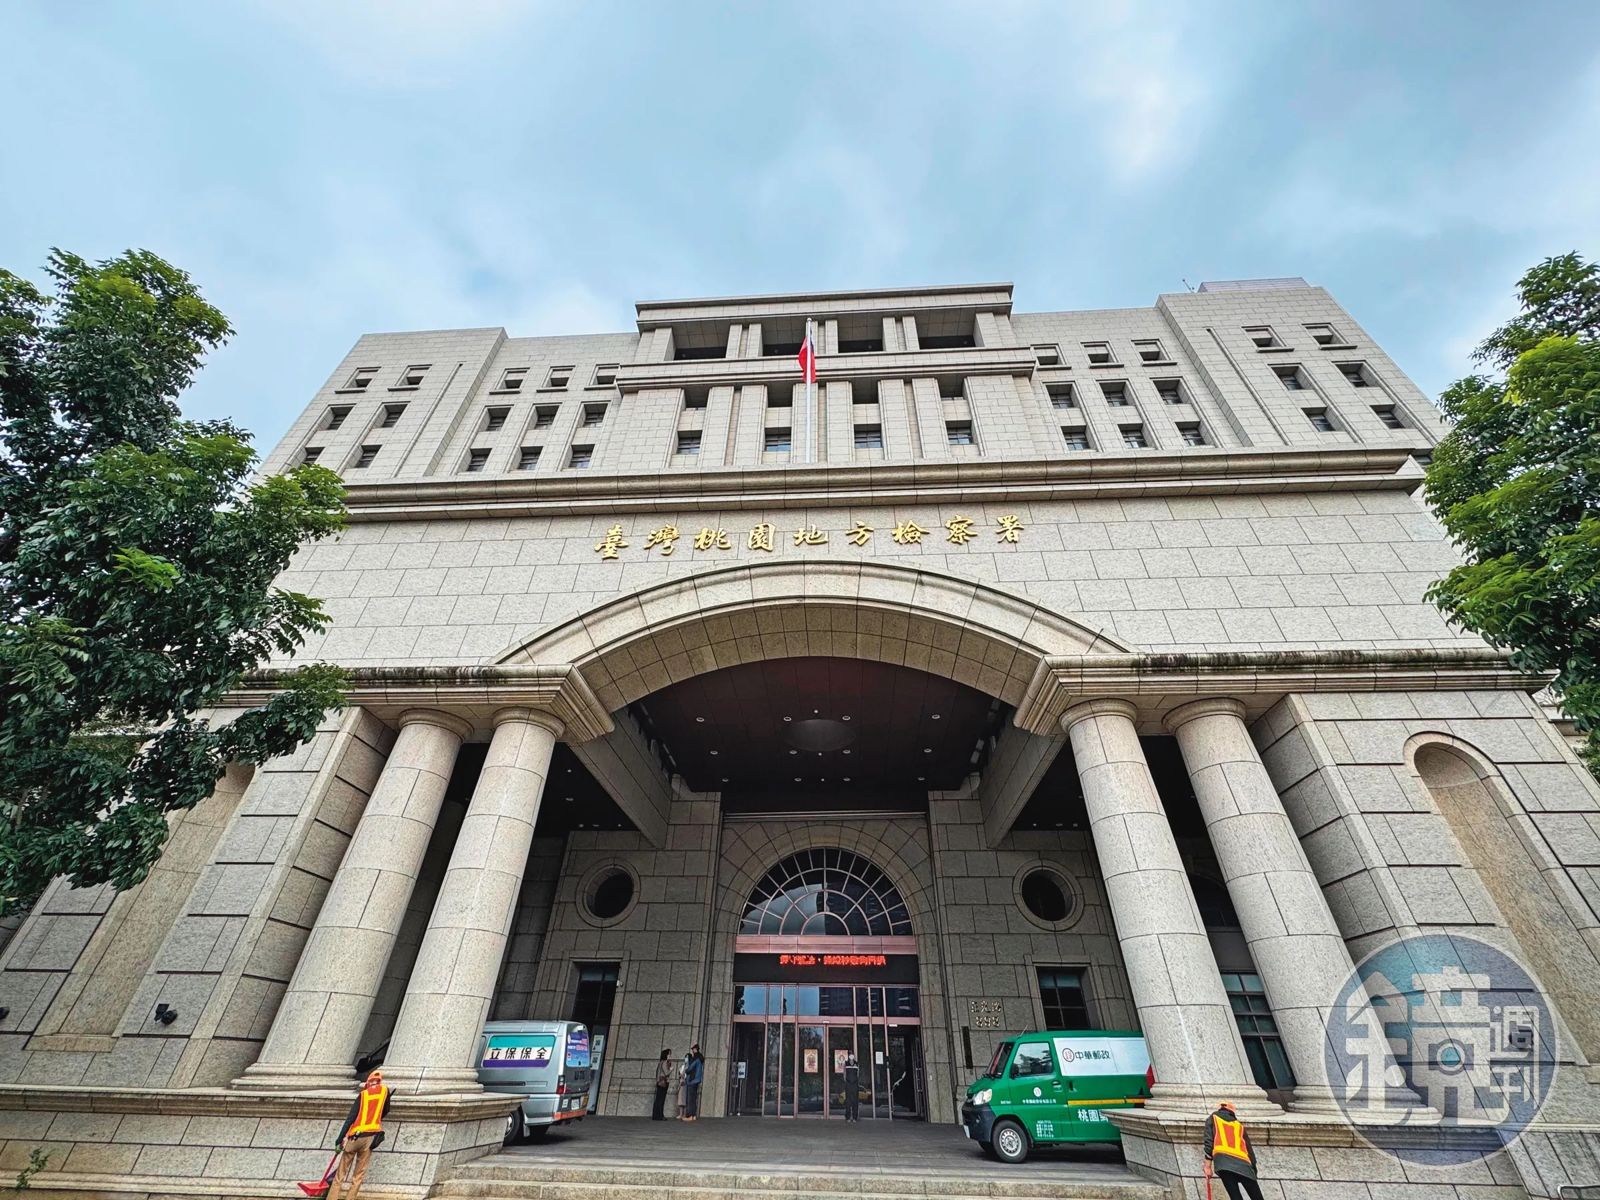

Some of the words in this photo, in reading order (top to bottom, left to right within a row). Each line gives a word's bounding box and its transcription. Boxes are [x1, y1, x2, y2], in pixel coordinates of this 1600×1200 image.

[594, 515, 1025, 559] 臺灣桃園地方檢察署
[490, 1047, 547, 1060] 立保保全
[1074, 1050, 1110, 1060] 中華郵政
